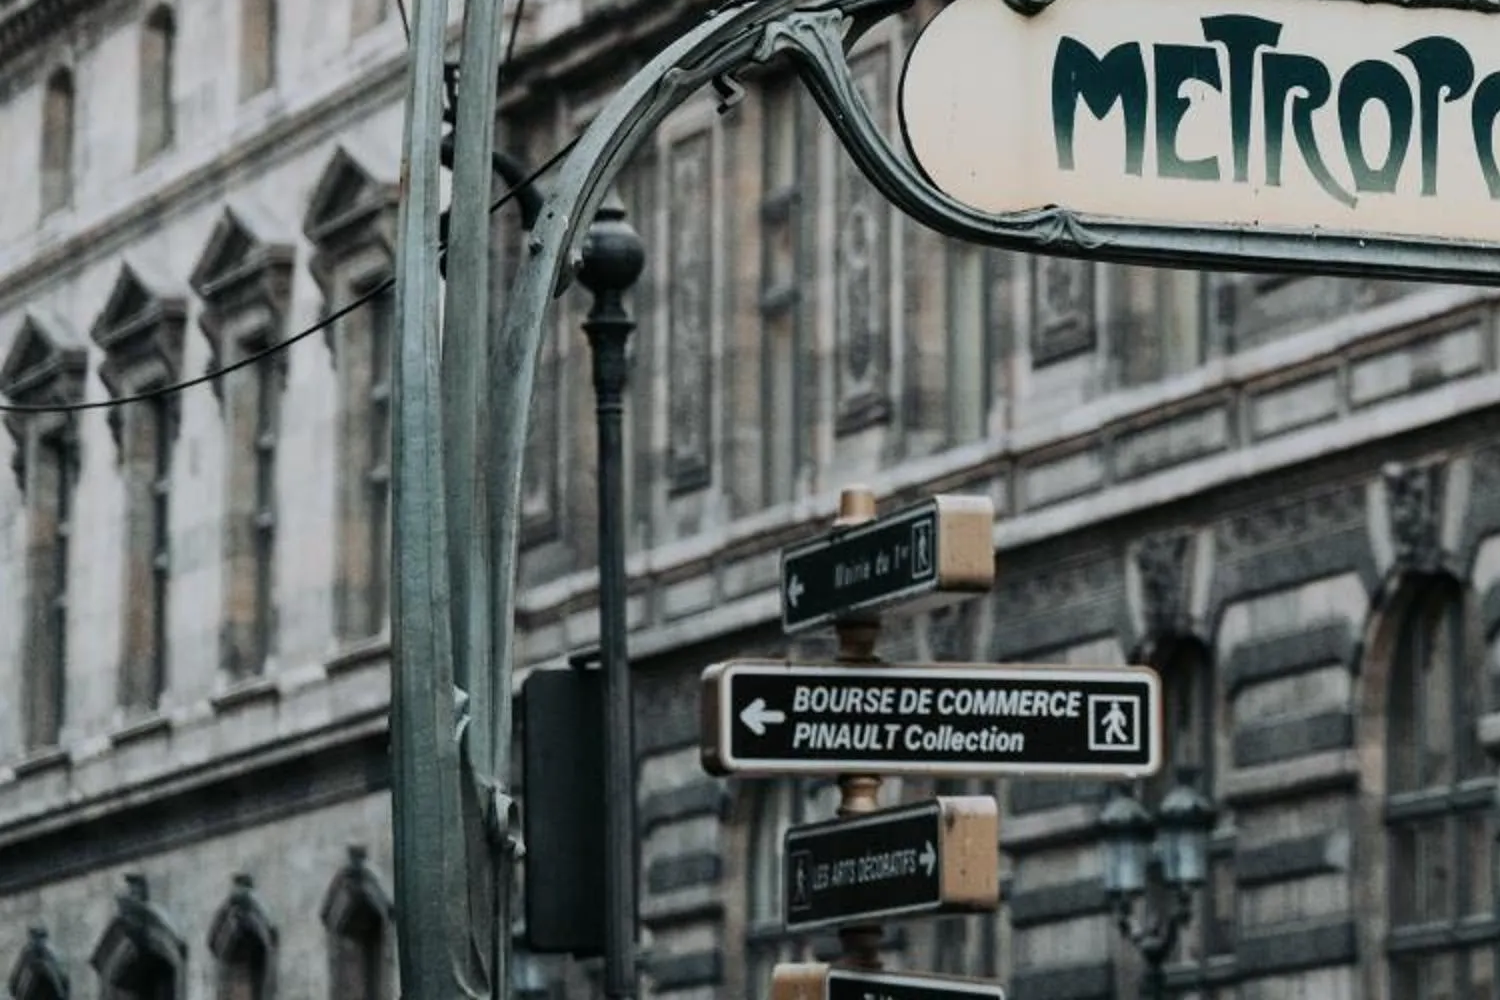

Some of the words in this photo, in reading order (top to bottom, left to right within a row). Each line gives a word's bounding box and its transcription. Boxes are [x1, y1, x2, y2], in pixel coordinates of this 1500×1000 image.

[875, 551, 890, 576] du
[793, 686, 895, 713] BOURSE
[898, 688, 933, 715] DE
[937, 690, 1082, 717] COMMERCE
[793, 723, 900, 750] PINAULT
[904, 725, 1025, 752] Collection
